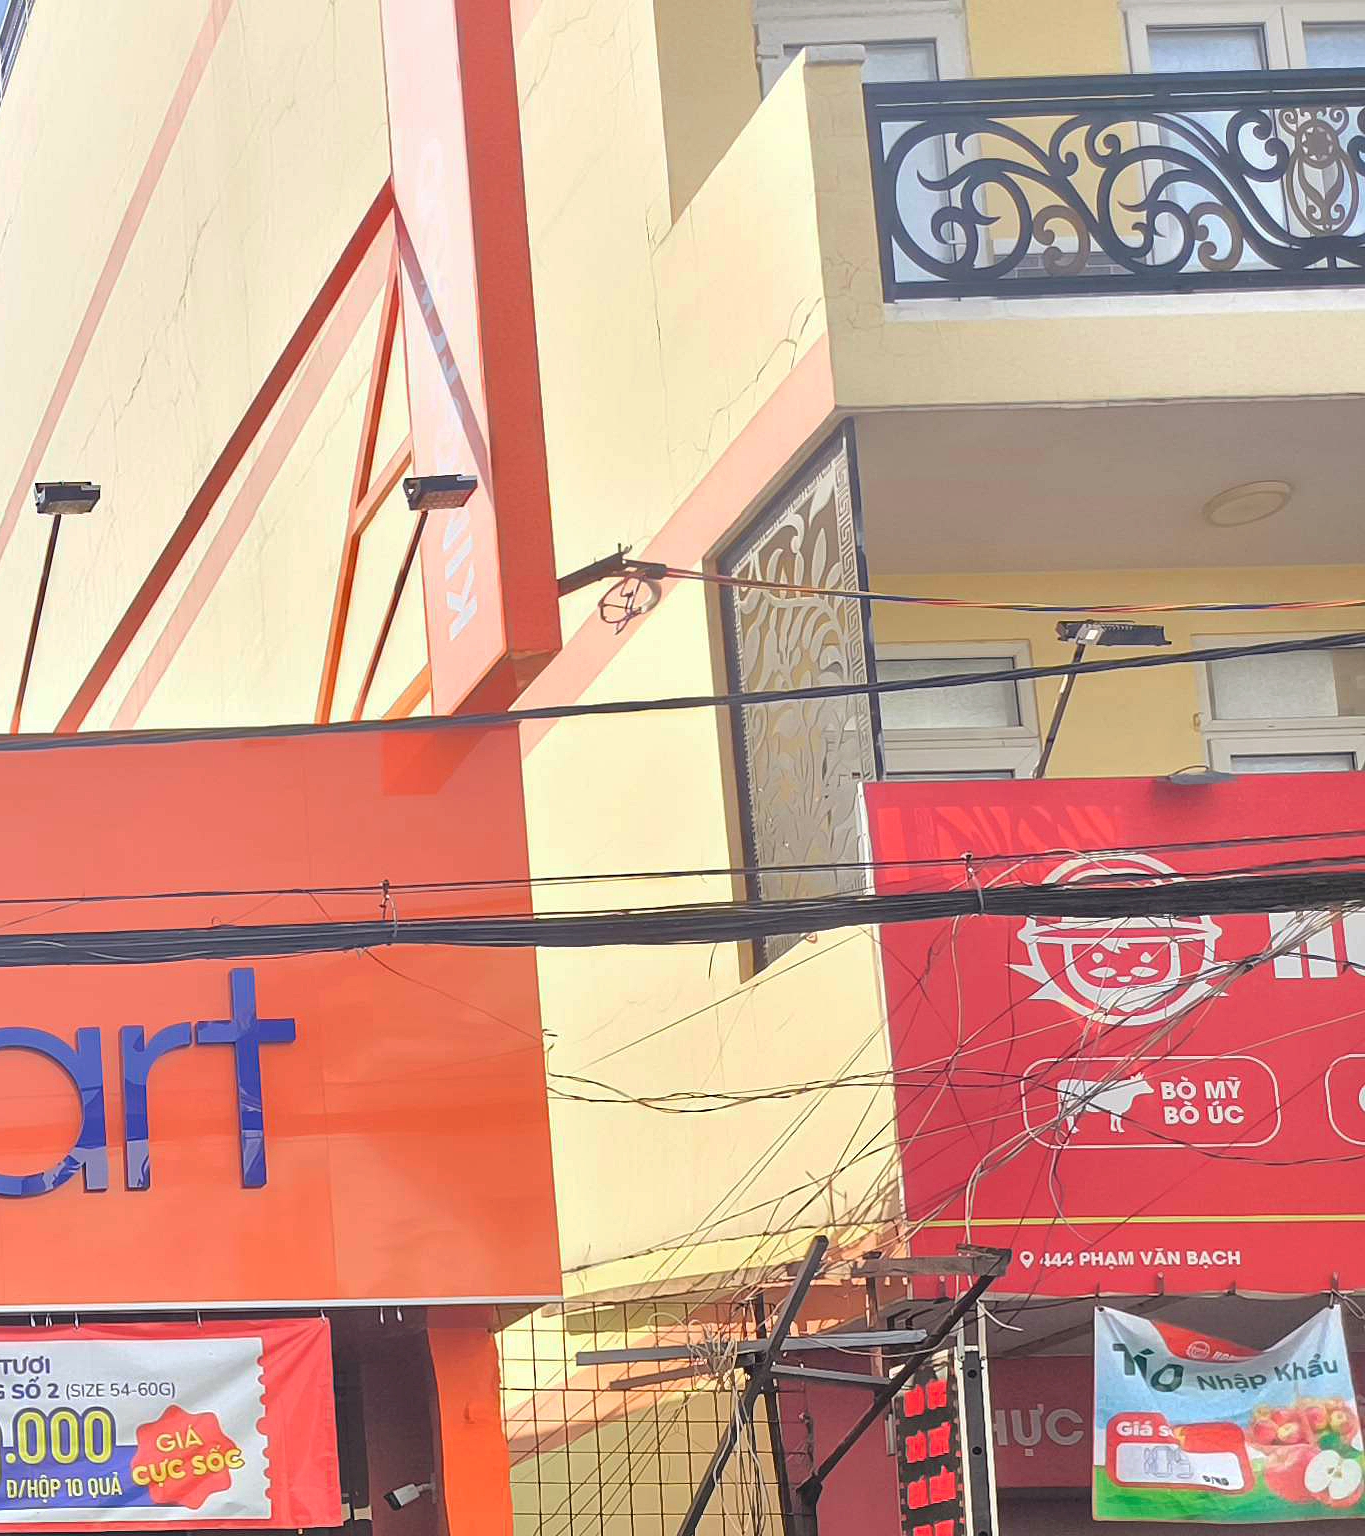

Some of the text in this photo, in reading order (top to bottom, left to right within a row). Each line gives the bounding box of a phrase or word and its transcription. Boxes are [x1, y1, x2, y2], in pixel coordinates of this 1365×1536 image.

[1160, 1076, 1240, 1100] BÒ MỸ
[1164, 1101, 1245, 1124] BÒ ÚC
[1079, 1251, 1134, 1270] PHẠM
[1139, 1248, 1180, 1265] VĂN
[1186, 1251, 1241, 1269] BẠCH
[0, 1356, 51, 1375] TƯƠI
[1197, 1373, 1268, 1393] Nhập
[1274, 1354, 1339, 1382] Khẩu
[11, 1377, 41, 1399] SỐ
[47, 1383, 60, 1399] 2
[65, 1383, 106, 1400] (SIZE
[110, 1382, 176, 1398] 54-60G)
[156, 1424, 203, 1452] GIÁ
[1117, 1422, 1154, 1437] Giá
[132, 1444, 245, 1487] CỰC SỐC
[6, 1472, 122, 1503] Đ/HỘP 10 QUẢ
